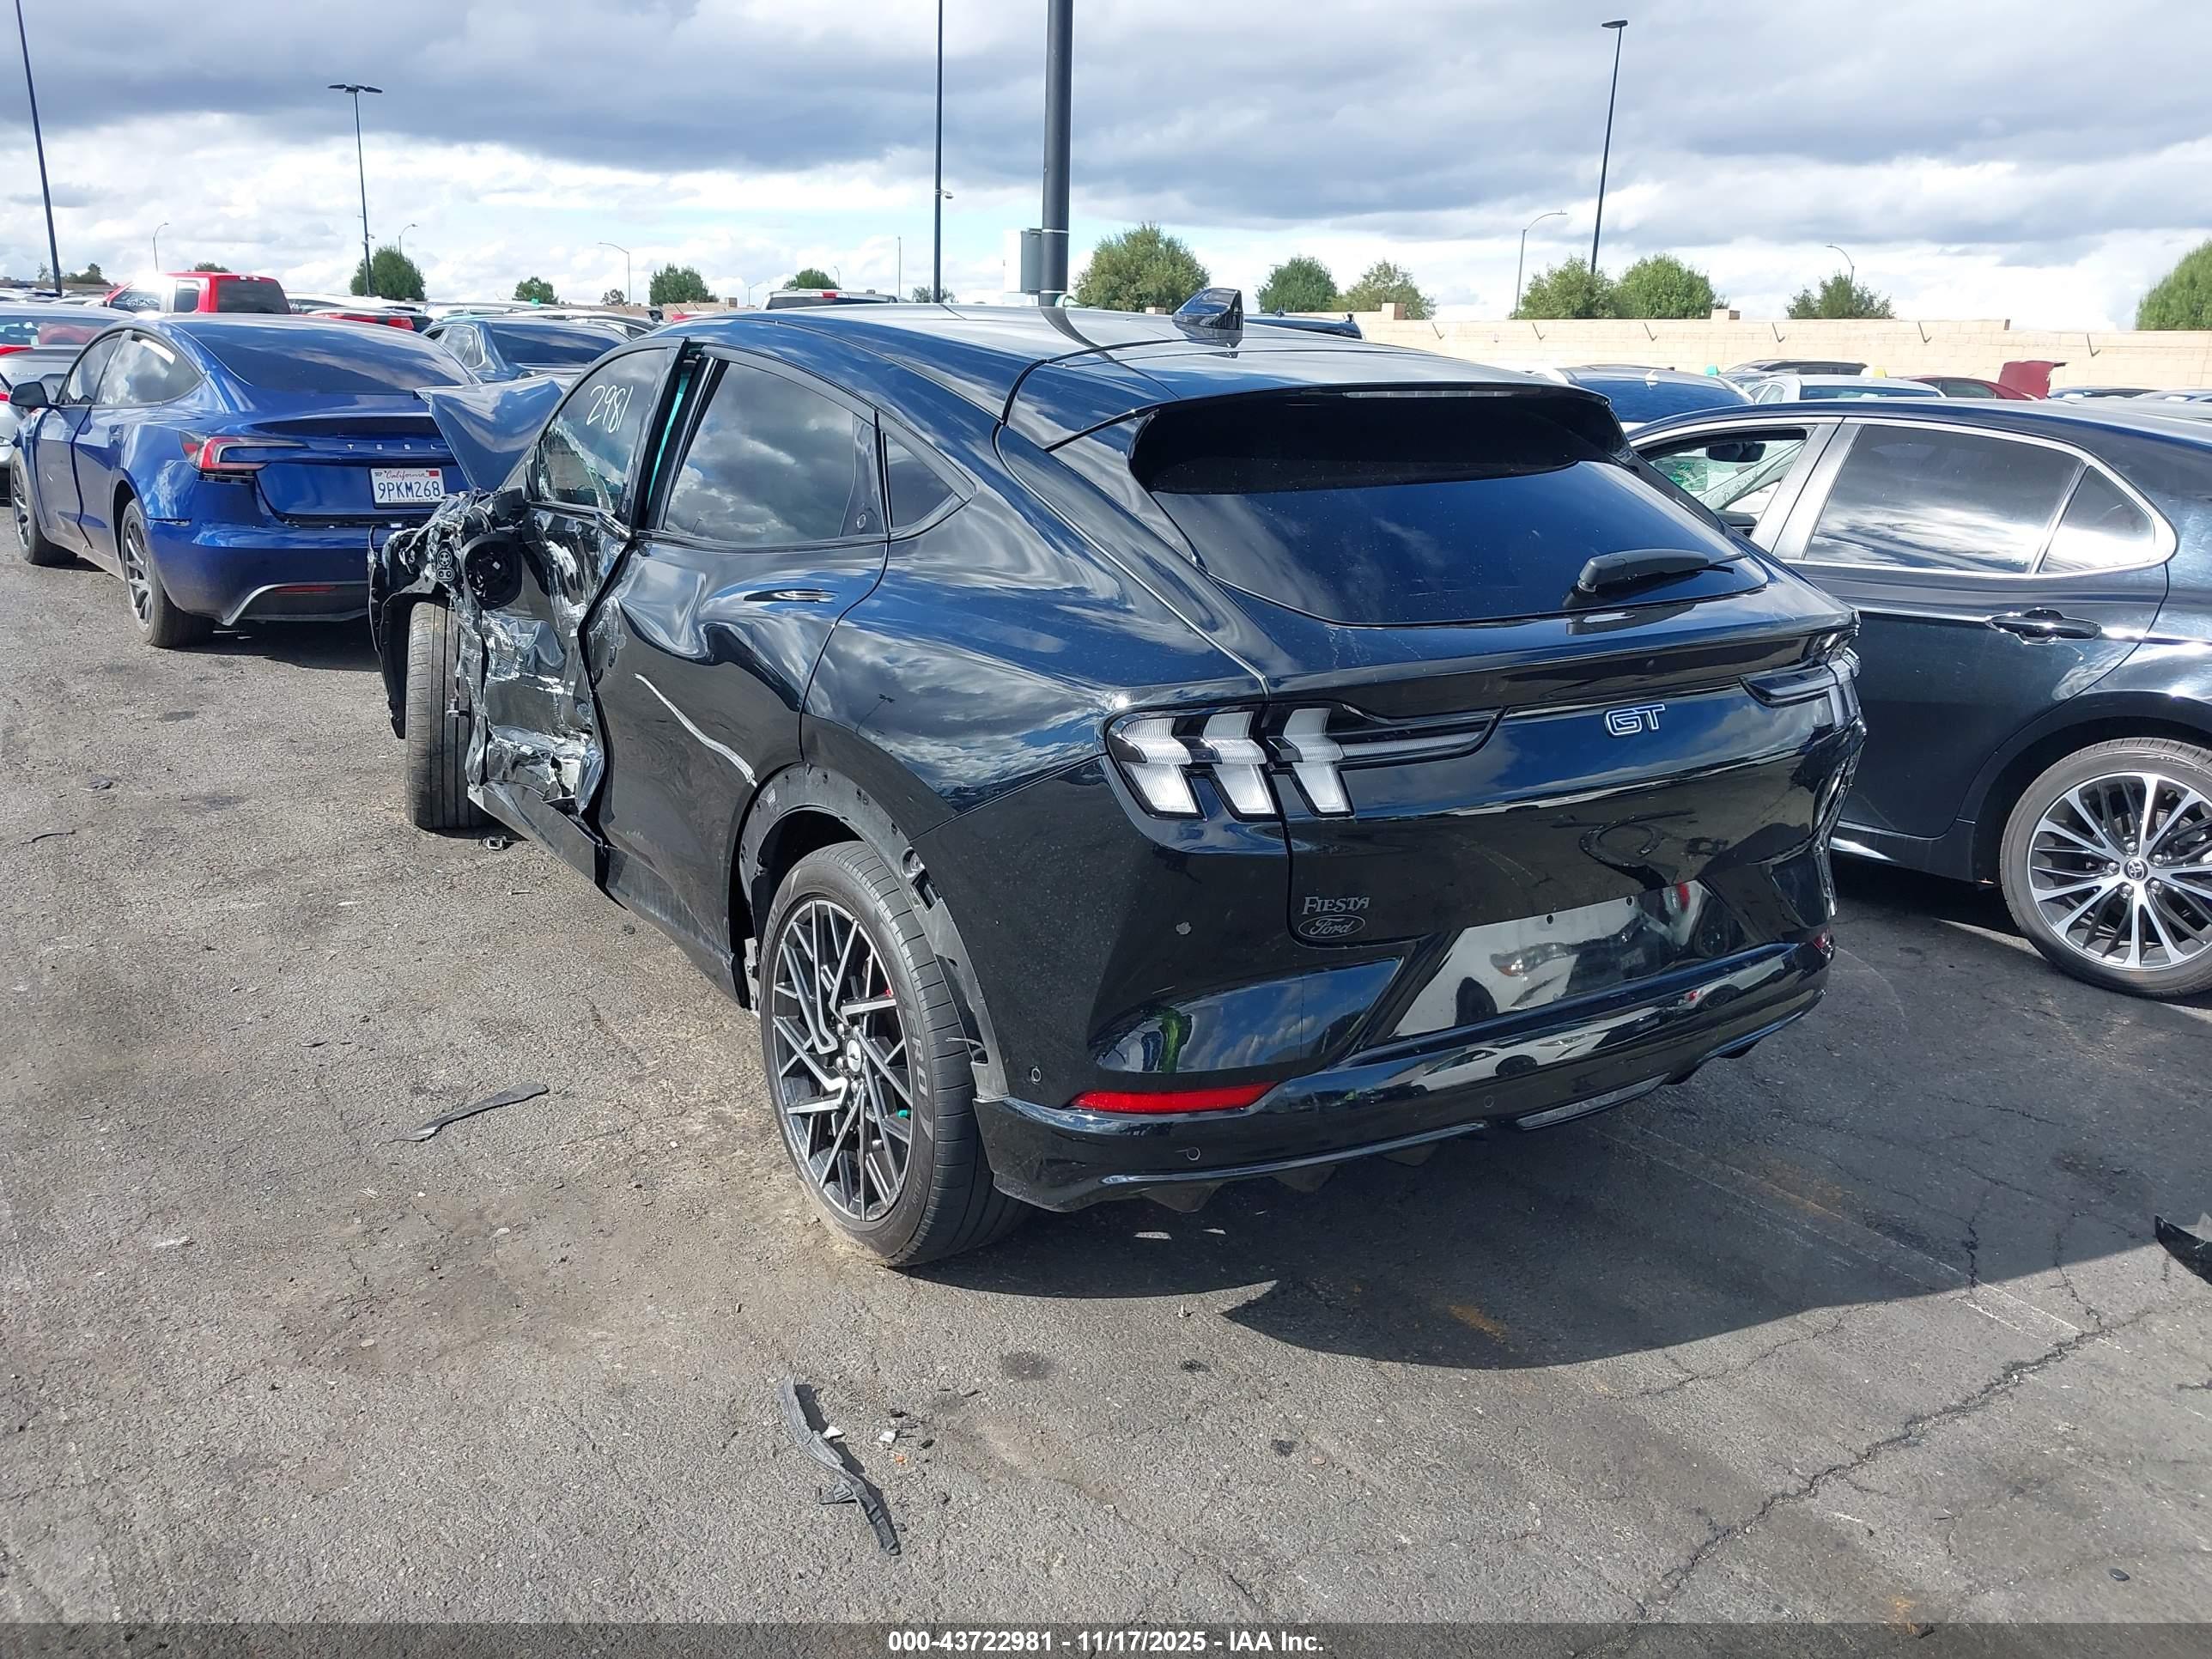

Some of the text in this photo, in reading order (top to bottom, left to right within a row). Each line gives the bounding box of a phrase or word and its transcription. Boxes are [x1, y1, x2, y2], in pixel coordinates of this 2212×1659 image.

[586, 385, 634, 434] 2981
[386, 470, 428, 480] California
[378, 481, 441, 499] 9PKM268
[1606, 704, 1666, 736] GT
[1309, 918, 1355, 935] Ford
